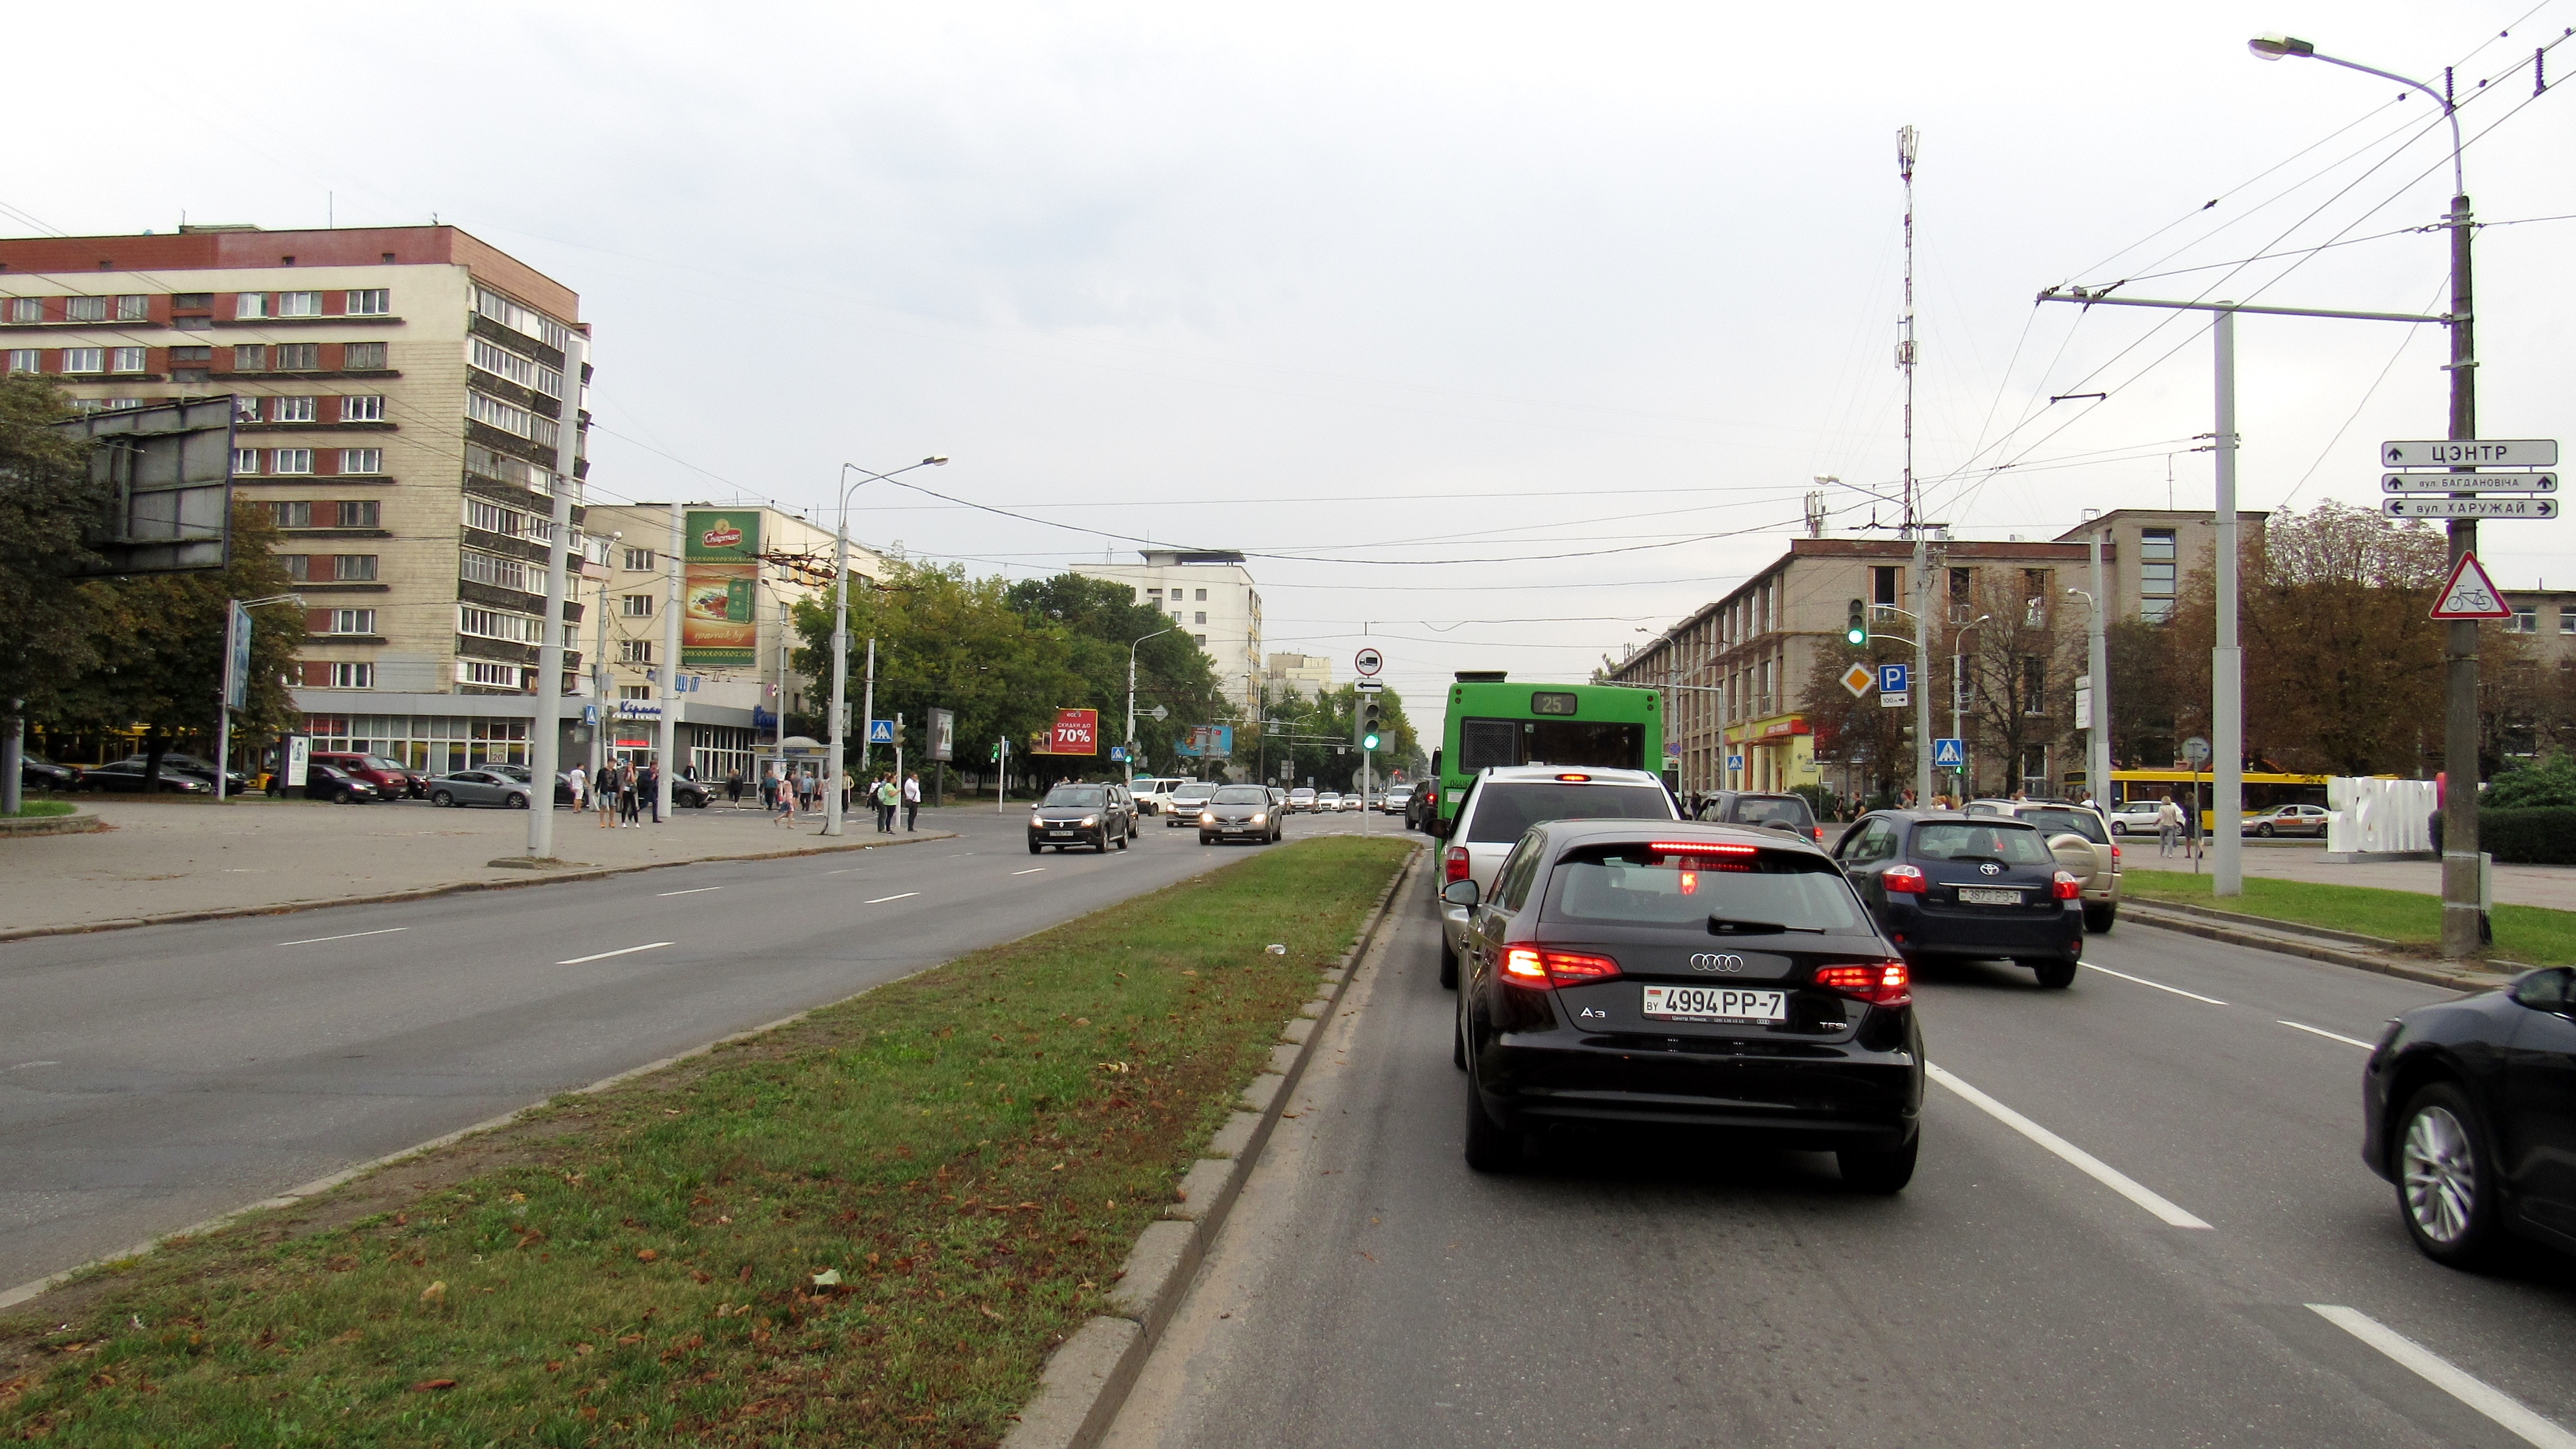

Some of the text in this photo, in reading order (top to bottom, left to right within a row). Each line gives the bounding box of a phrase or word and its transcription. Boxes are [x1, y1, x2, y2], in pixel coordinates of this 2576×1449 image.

[2432, 446, 2507, 463] ЦЭНТР
[2419, 479, 2518, 489] вул. БАГДАНОВІЧА
[2417, 501, 2525, 515] вул. ХАРУЖАЙ
[1886, 668, 1901, 689] P
[1543, 696, 1561, 713] 25
[1058, 729, 1091, 742] 70%
[1580, 1007, 1606, 1018] A3
[1646, 1002, 1659, 1011] BY
